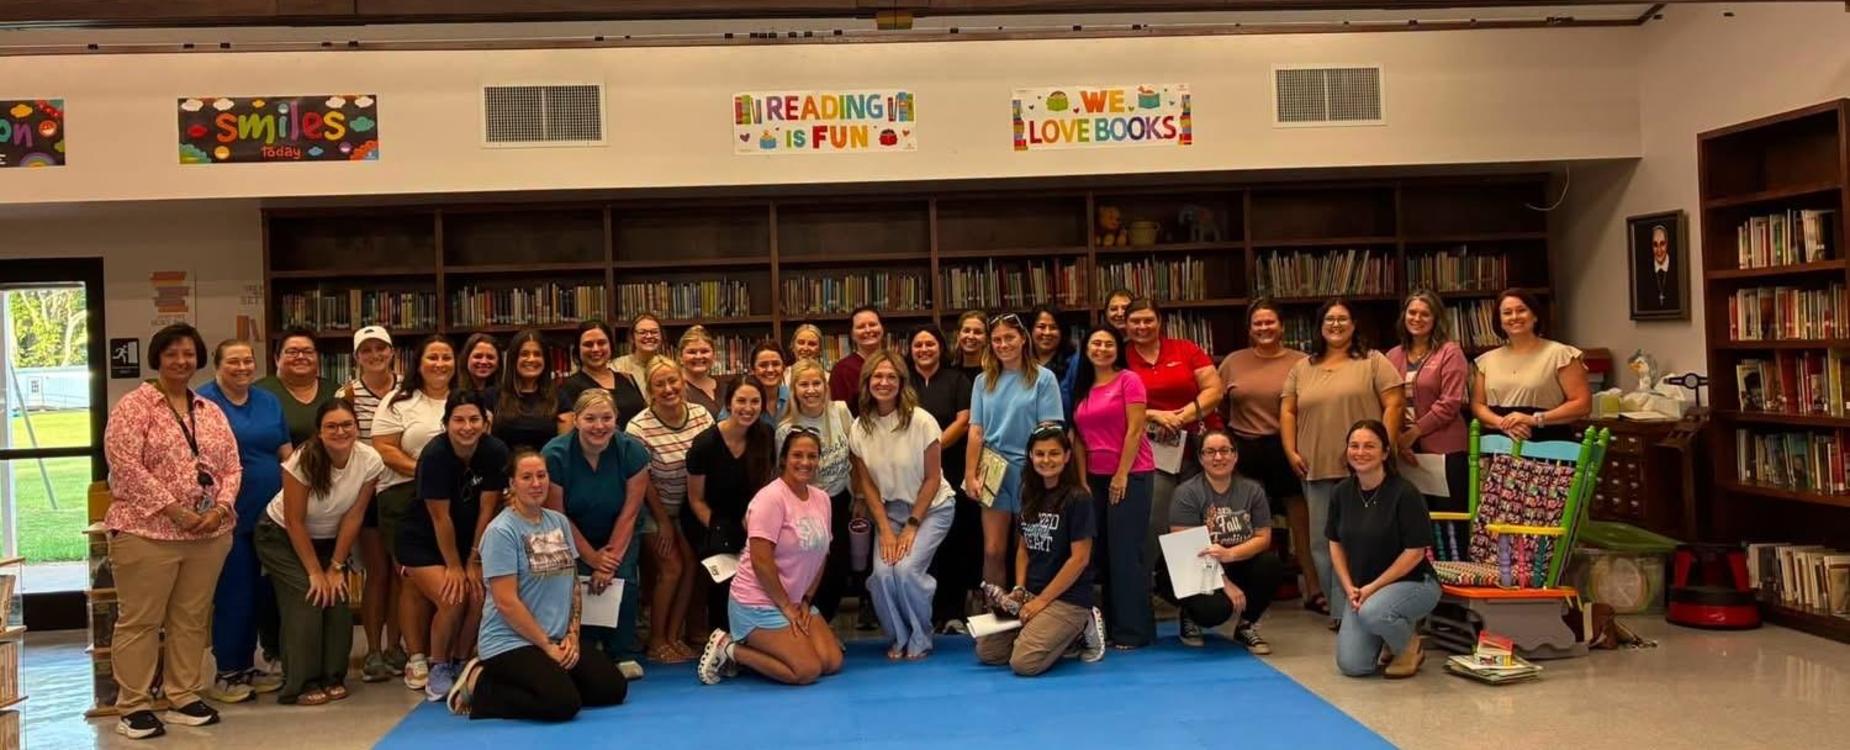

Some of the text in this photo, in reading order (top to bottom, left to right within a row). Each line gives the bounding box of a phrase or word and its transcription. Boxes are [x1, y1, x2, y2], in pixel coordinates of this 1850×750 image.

[766, 93, 883, 121] READING
[1080, 89, 1125, 113] WE
[215, 100, 346, 145] smiles
[1029, 115, 1177, 144] LOVE BOOKS
[786, 124, 869, 149] IS FUN
[260, 145, 301, 160] Today
